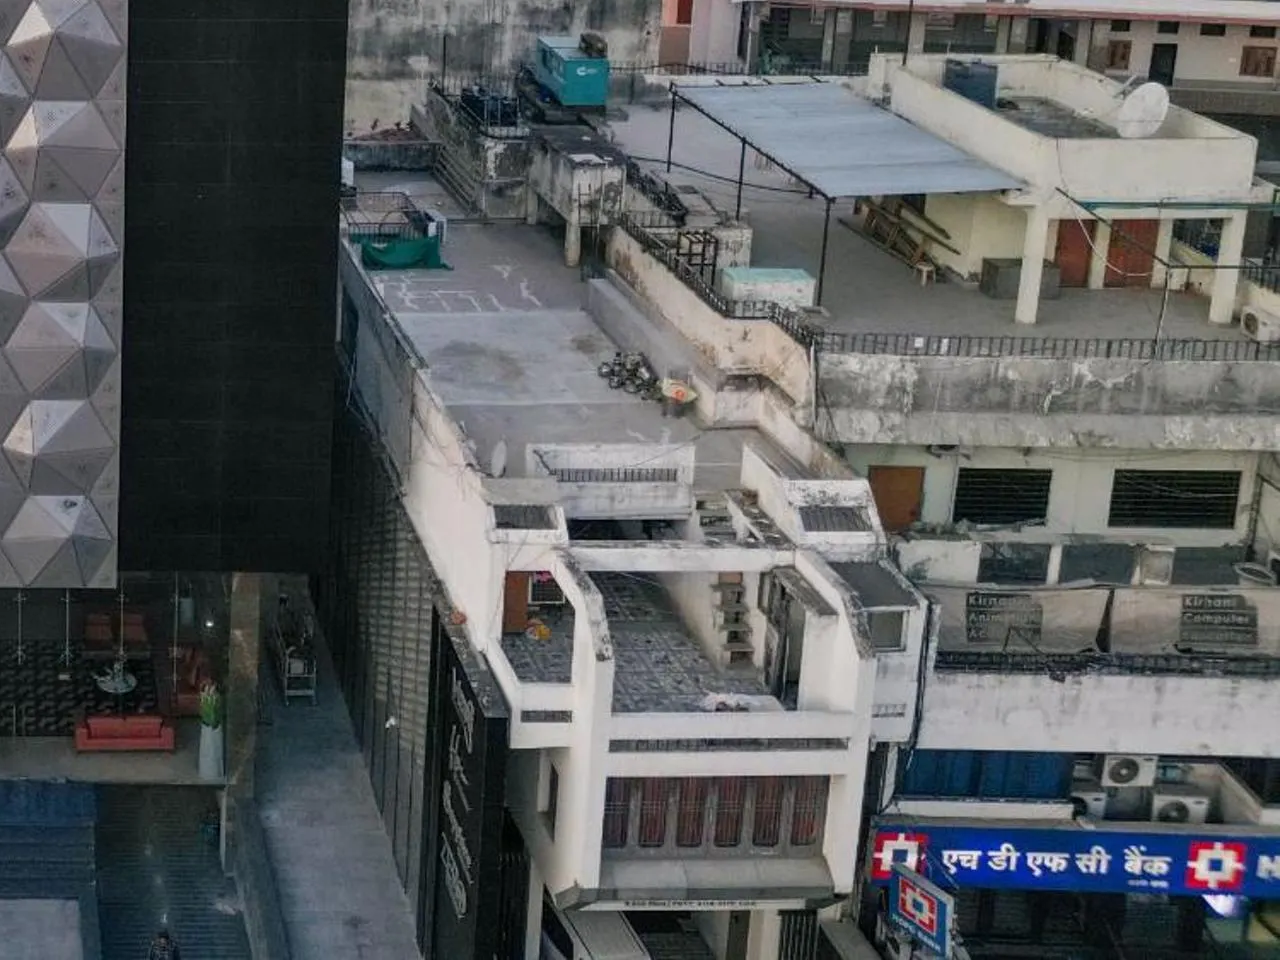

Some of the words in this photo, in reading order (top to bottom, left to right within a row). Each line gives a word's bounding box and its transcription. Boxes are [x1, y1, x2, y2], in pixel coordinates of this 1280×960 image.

[942, 850, 982, 874] एच
[987, 843, 1021, 871] डी
[1026, 852, 1070, 877] एफ
[1075, 845, 1112, 874] सी
[1123, 845, 1173, 876] बैंक
